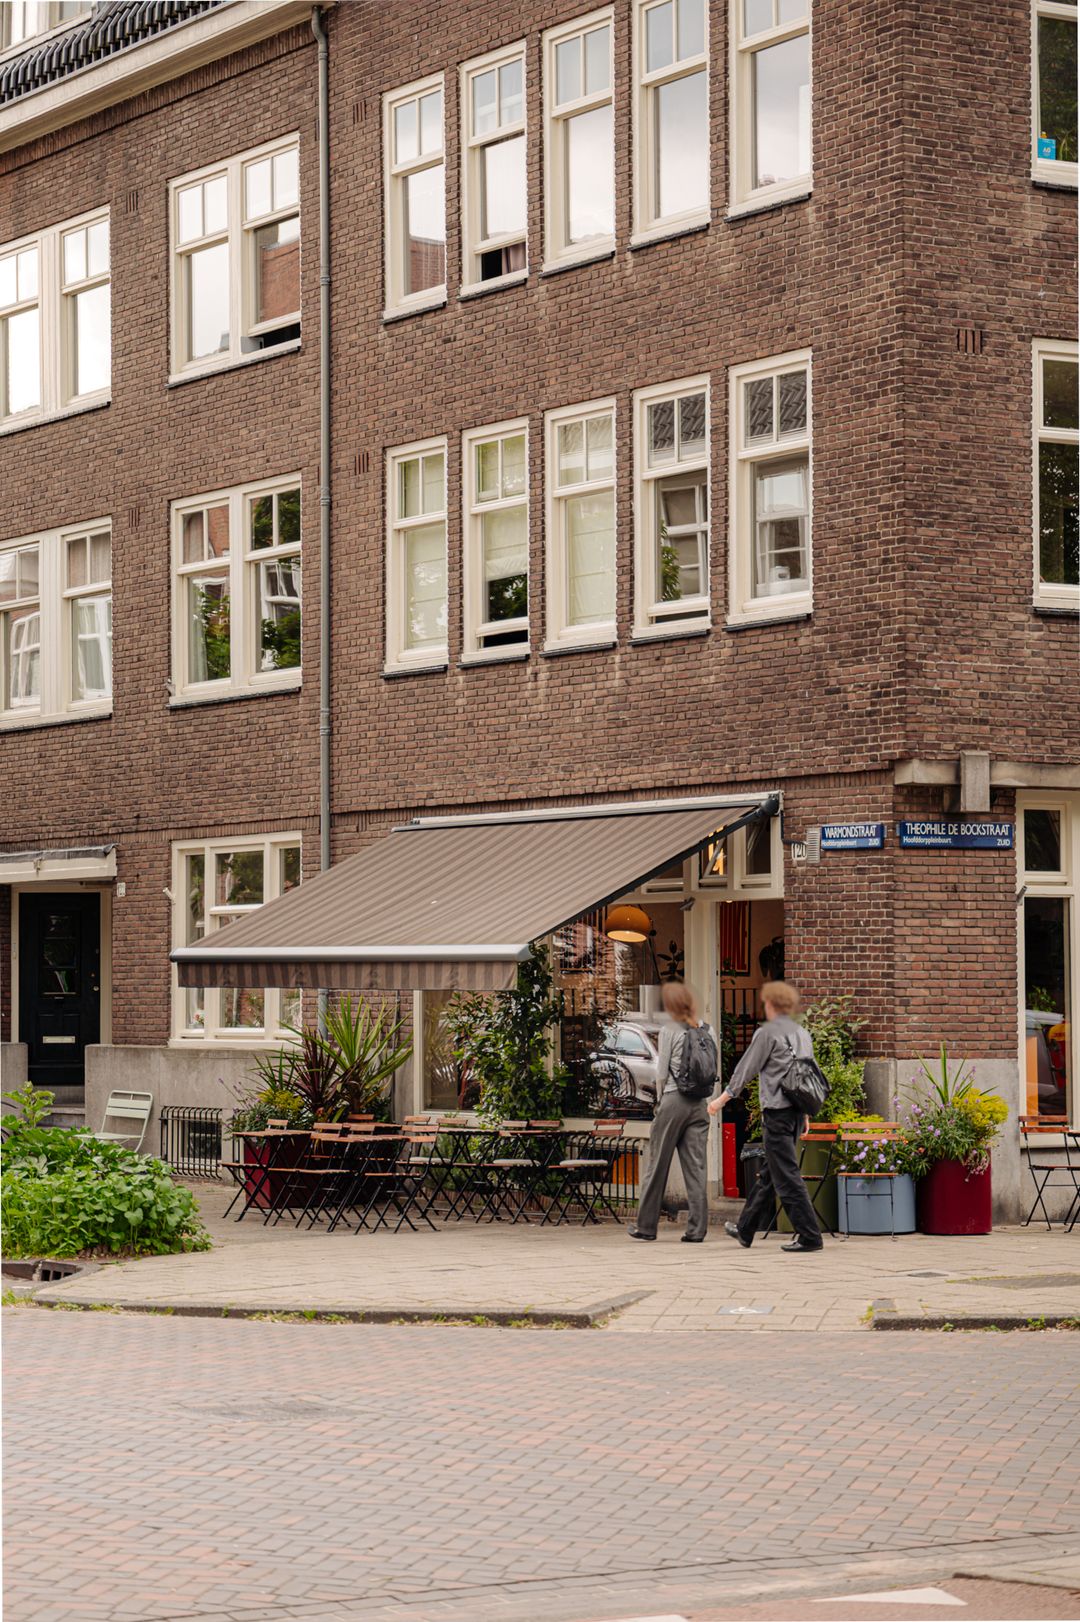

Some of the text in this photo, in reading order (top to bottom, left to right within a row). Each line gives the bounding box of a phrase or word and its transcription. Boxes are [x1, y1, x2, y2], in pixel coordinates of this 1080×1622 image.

[824, 825, 877, 838] WARMONDSTRAAT
[906, 823, 1010, 836] THEOPHILE DE BOCKSTRAAT
[868, 838, 880, 846] ZUID
[904, 836, 952, 844] Hoofddorppleinbuurt
